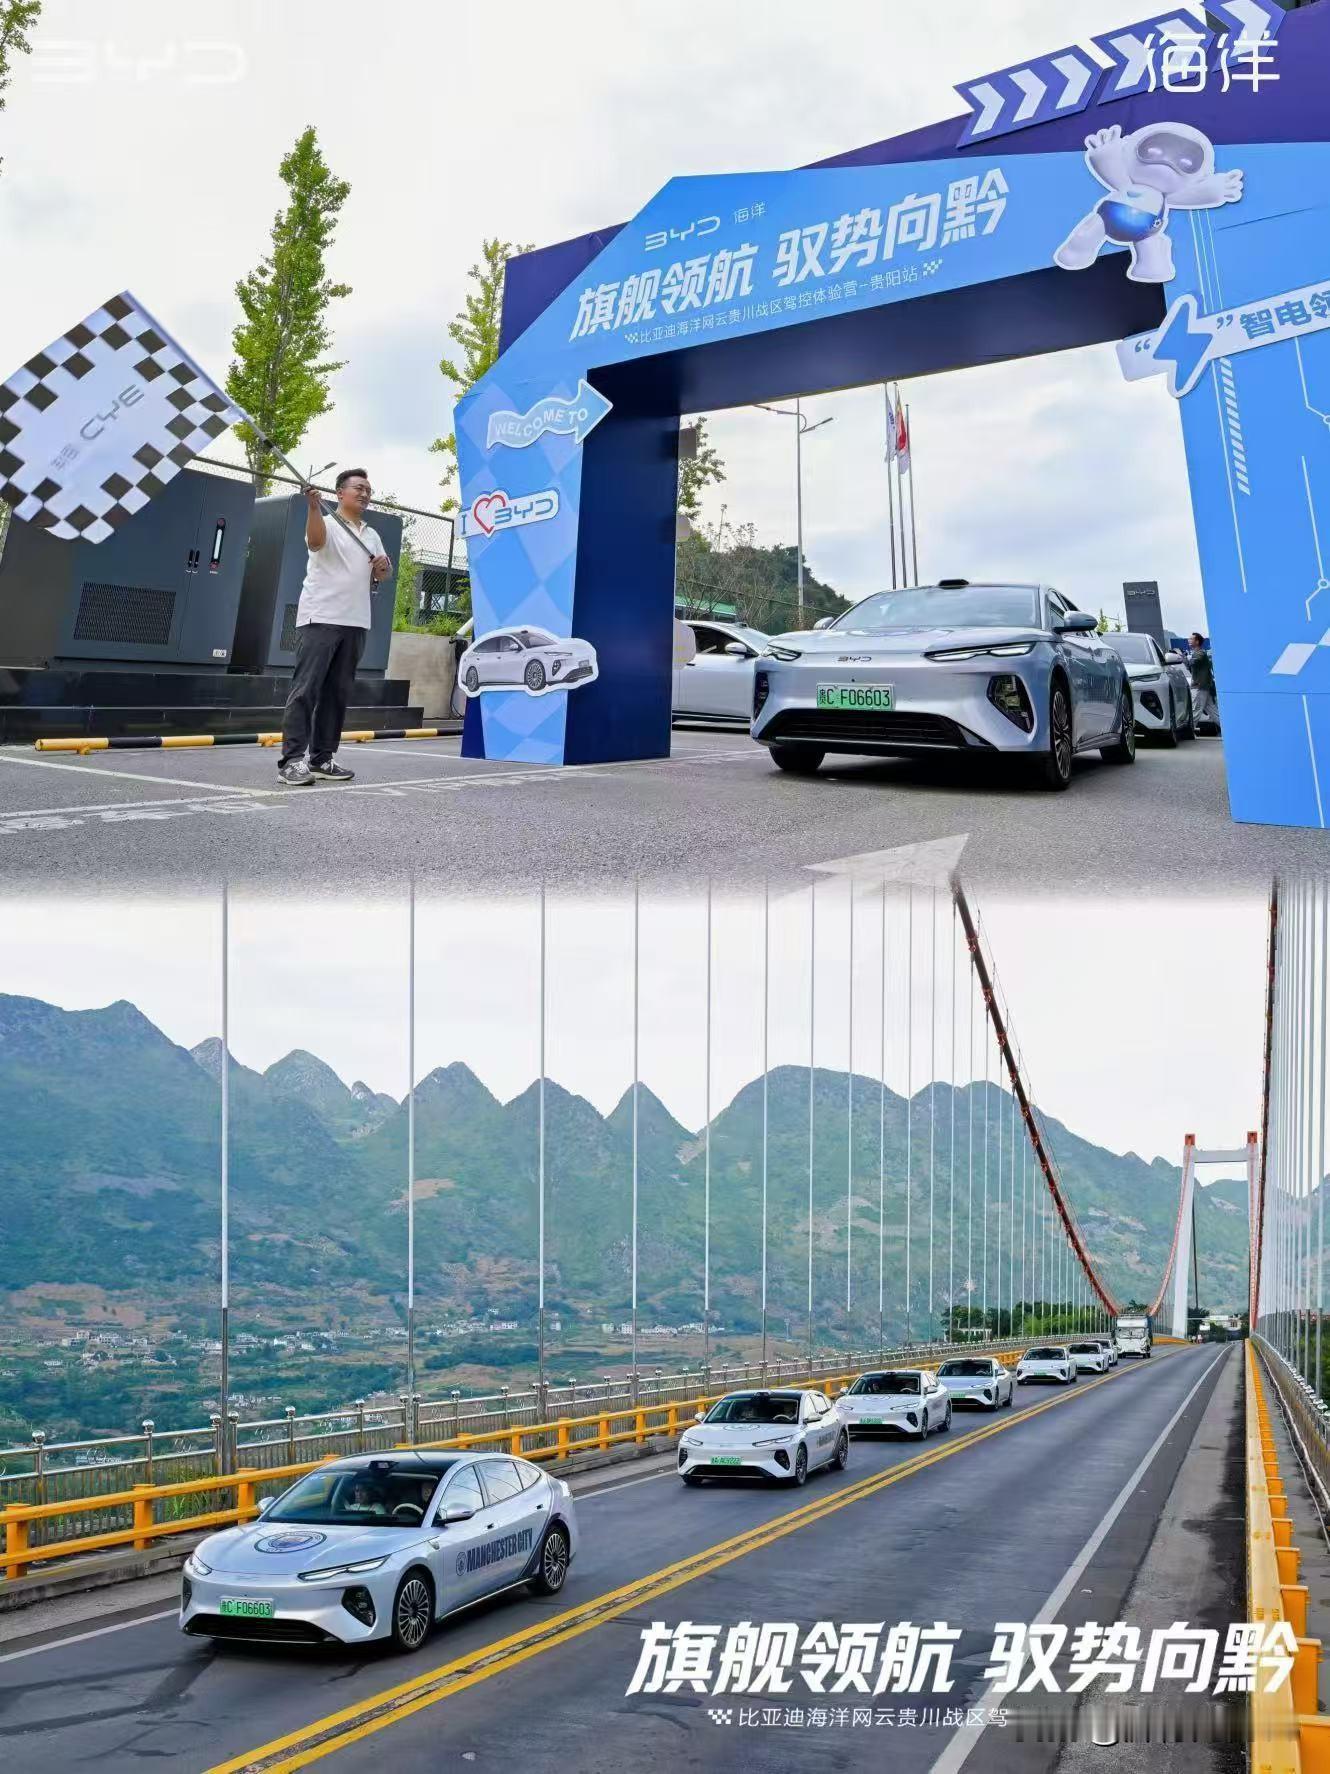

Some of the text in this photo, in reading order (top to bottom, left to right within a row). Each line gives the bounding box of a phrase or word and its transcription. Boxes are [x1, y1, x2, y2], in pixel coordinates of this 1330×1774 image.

[644, 201, 766, 251] BYD 海洋
[568, 167, 1010, 342] 旗舰领航 驭势向黔
[495, 408, 588, 437] WELCOME TO
[494, 499, 553, 525] BYD
[840, 689, 891, 707] F06603
[466, 1527, 534, 1573] MANCHESTER CITY
[236, 1601, 271, 1616] F06603
